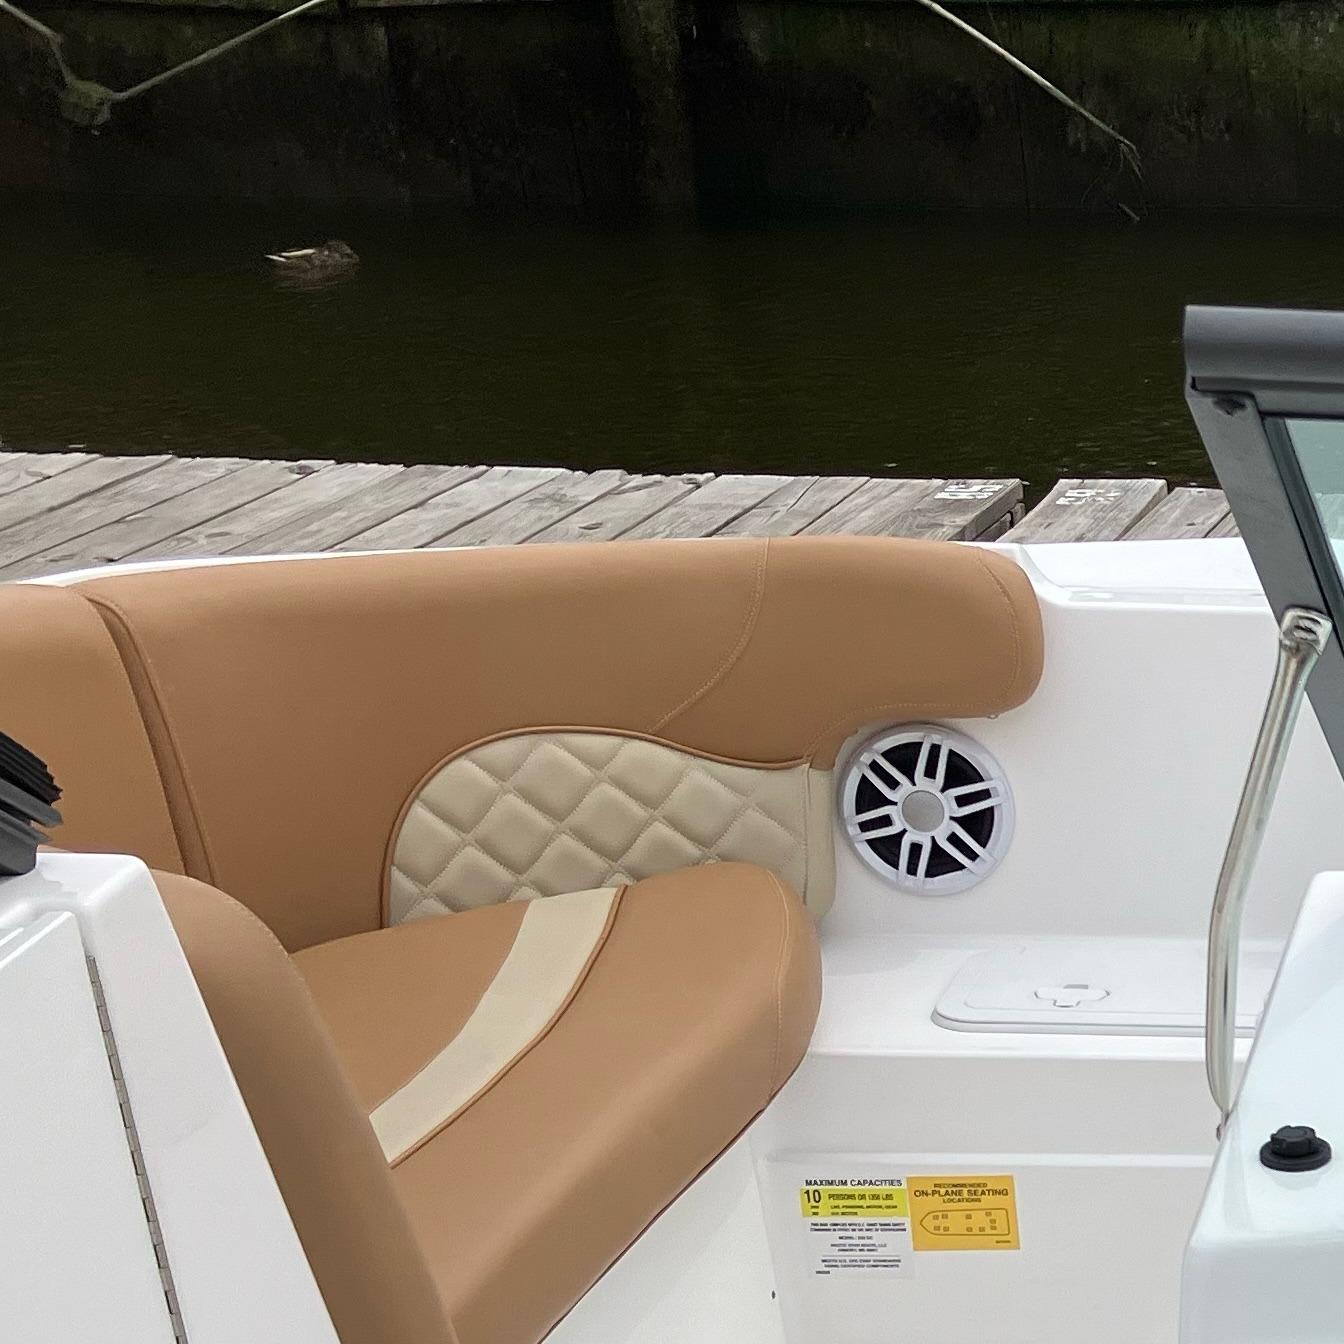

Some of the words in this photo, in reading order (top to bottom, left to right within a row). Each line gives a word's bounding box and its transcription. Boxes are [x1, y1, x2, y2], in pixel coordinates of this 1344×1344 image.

[849, 1179, 903, 1187] CAPACITIES
[804, 1189, 822, 1204] 10
[828, 1193, 856, 1201] PERSONS
[913, 1189, 963, 1198] ON-PLANE
[966, 1188, 1009, 1197] SEATING
